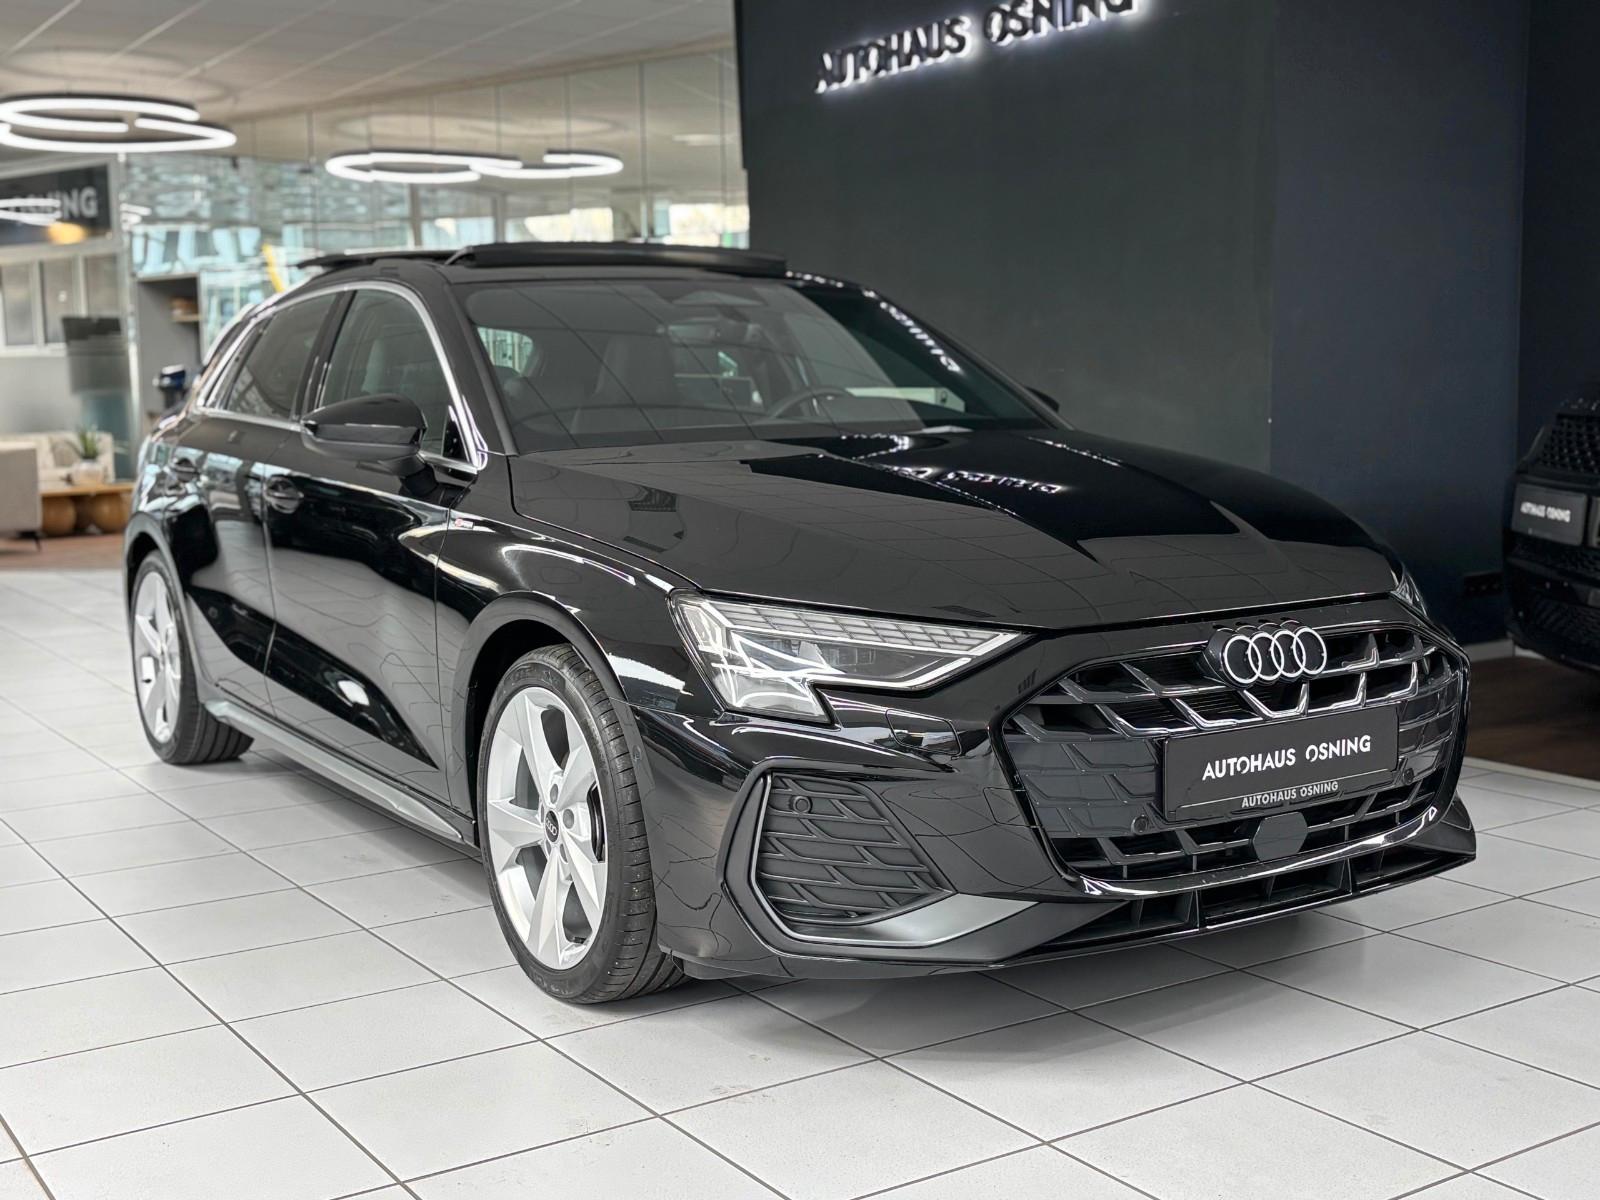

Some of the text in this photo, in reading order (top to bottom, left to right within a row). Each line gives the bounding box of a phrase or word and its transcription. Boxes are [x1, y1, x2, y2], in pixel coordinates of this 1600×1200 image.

[814, 15, 972, 93] AUTOHAUS
[1202, 735, 1371, 780] AUTOHAUS OSNING
[1241, 781, 1339, 808] AUTOHAUS OSNING
